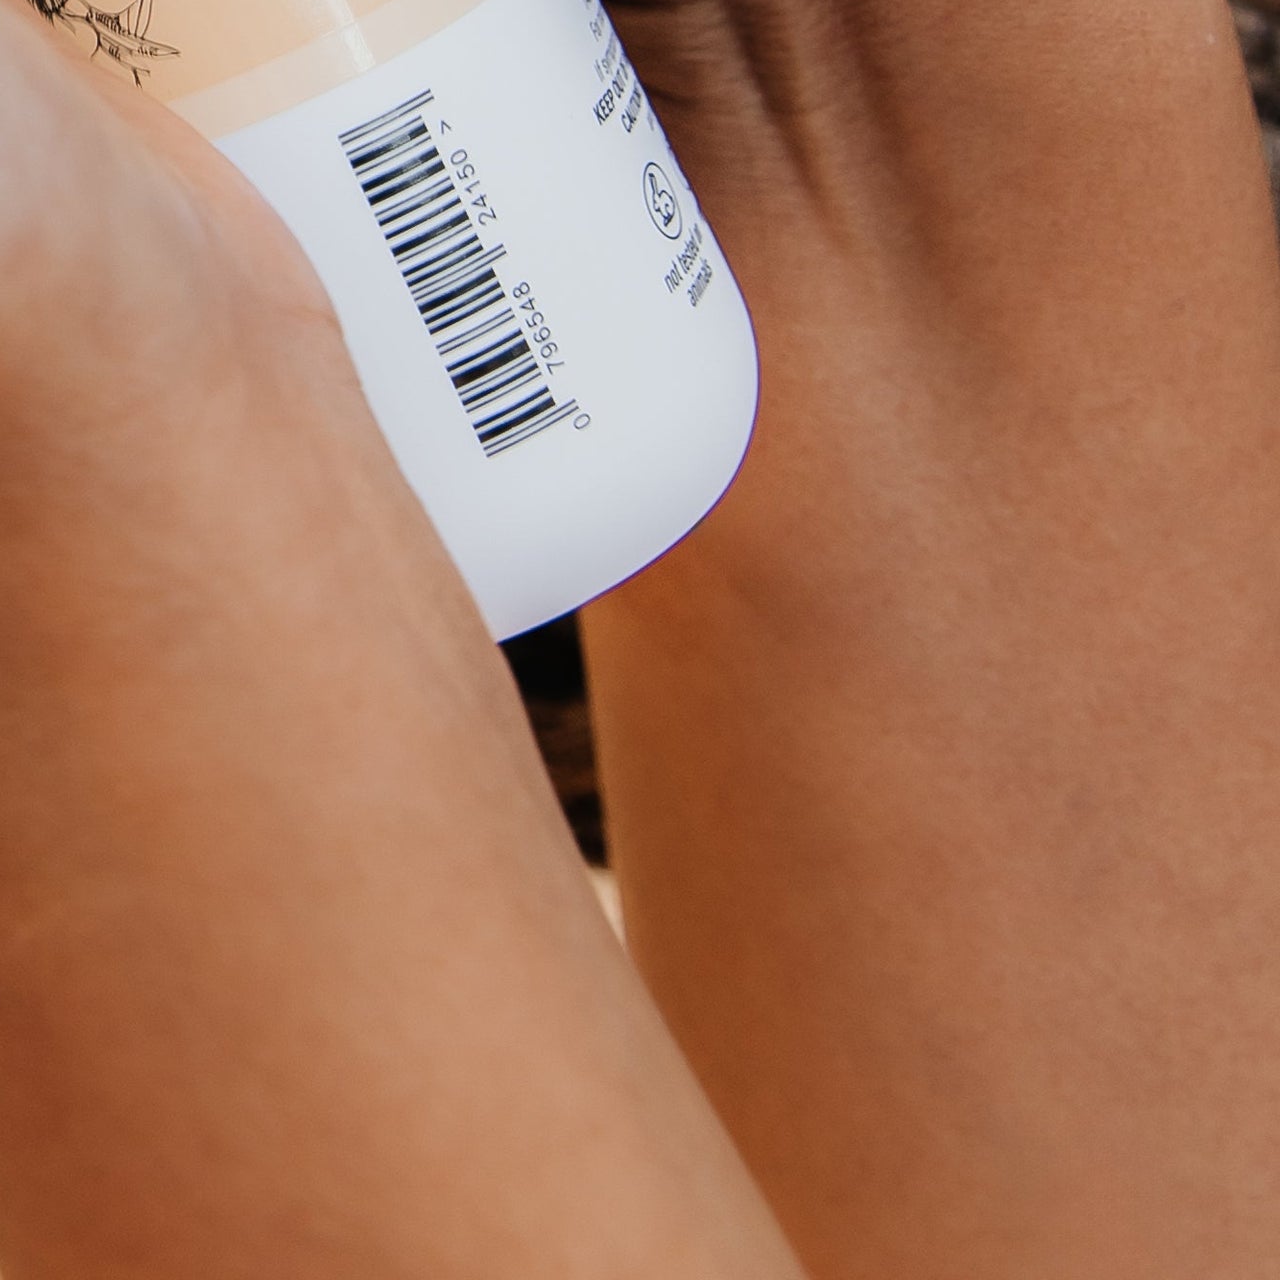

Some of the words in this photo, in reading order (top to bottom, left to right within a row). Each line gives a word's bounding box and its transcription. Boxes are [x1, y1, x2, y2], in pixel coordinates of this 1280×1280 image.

[593, 88, 616, 127] KEEP
[449, 147, 498, 226] 24150
[663, 260, 684, 294] not
[511, 280, 566, 376] 796548
[572, 412, 592, 431] 0
